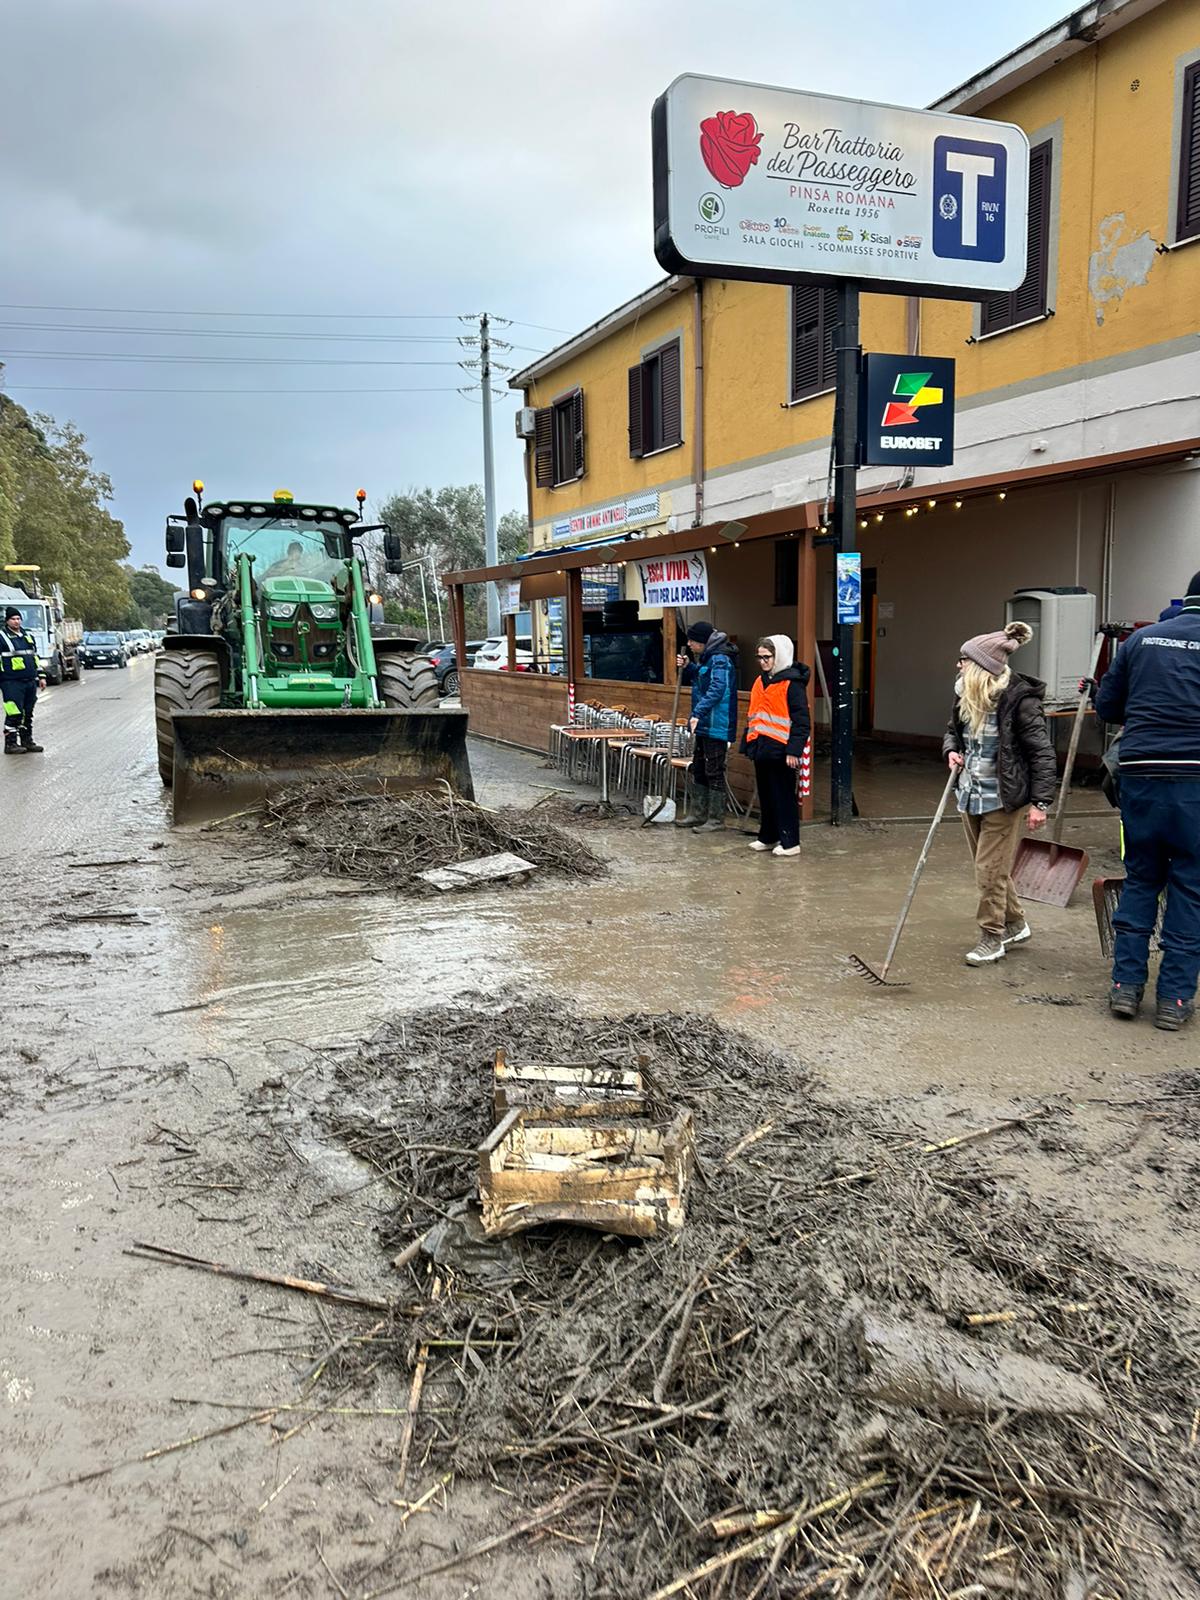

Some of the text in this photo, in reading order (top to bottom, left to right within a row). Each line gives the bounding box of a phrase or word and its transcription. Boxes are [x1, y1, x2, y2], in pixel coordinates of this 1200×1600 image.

[783, 123, 904, 162] Bar Trattoria
[766, 150, 917, 192] del Passeggero
[790, 185, 896, 209] PINSA ROMANA
[946, 151, 995, 247] T
[807, 202, 880, 219] Rosetta 1956
[985, 213, 995, 222] 16
[694, 223, 730, 236] PROFILI
[773, 217, 787, 228] 10
[743, 234, 766, 245] SALA
[769, 237, 804, 249] GIOCHI
[817, 242, 874, 256] SCOMMESSE
[877, 248, 919, 261] SPORTIVE
[870, 233, 891, 245] Sisal
[880, 436, 943, 450] EUROBET
[666, 559, 690, 581] VIVA
[660, 587, 670, 603] PER
[671, 586, 680, 602] LA
[681, 585, 705, 602] PESCA
[1141, 637, 1188, 649] PROTEZIONE
